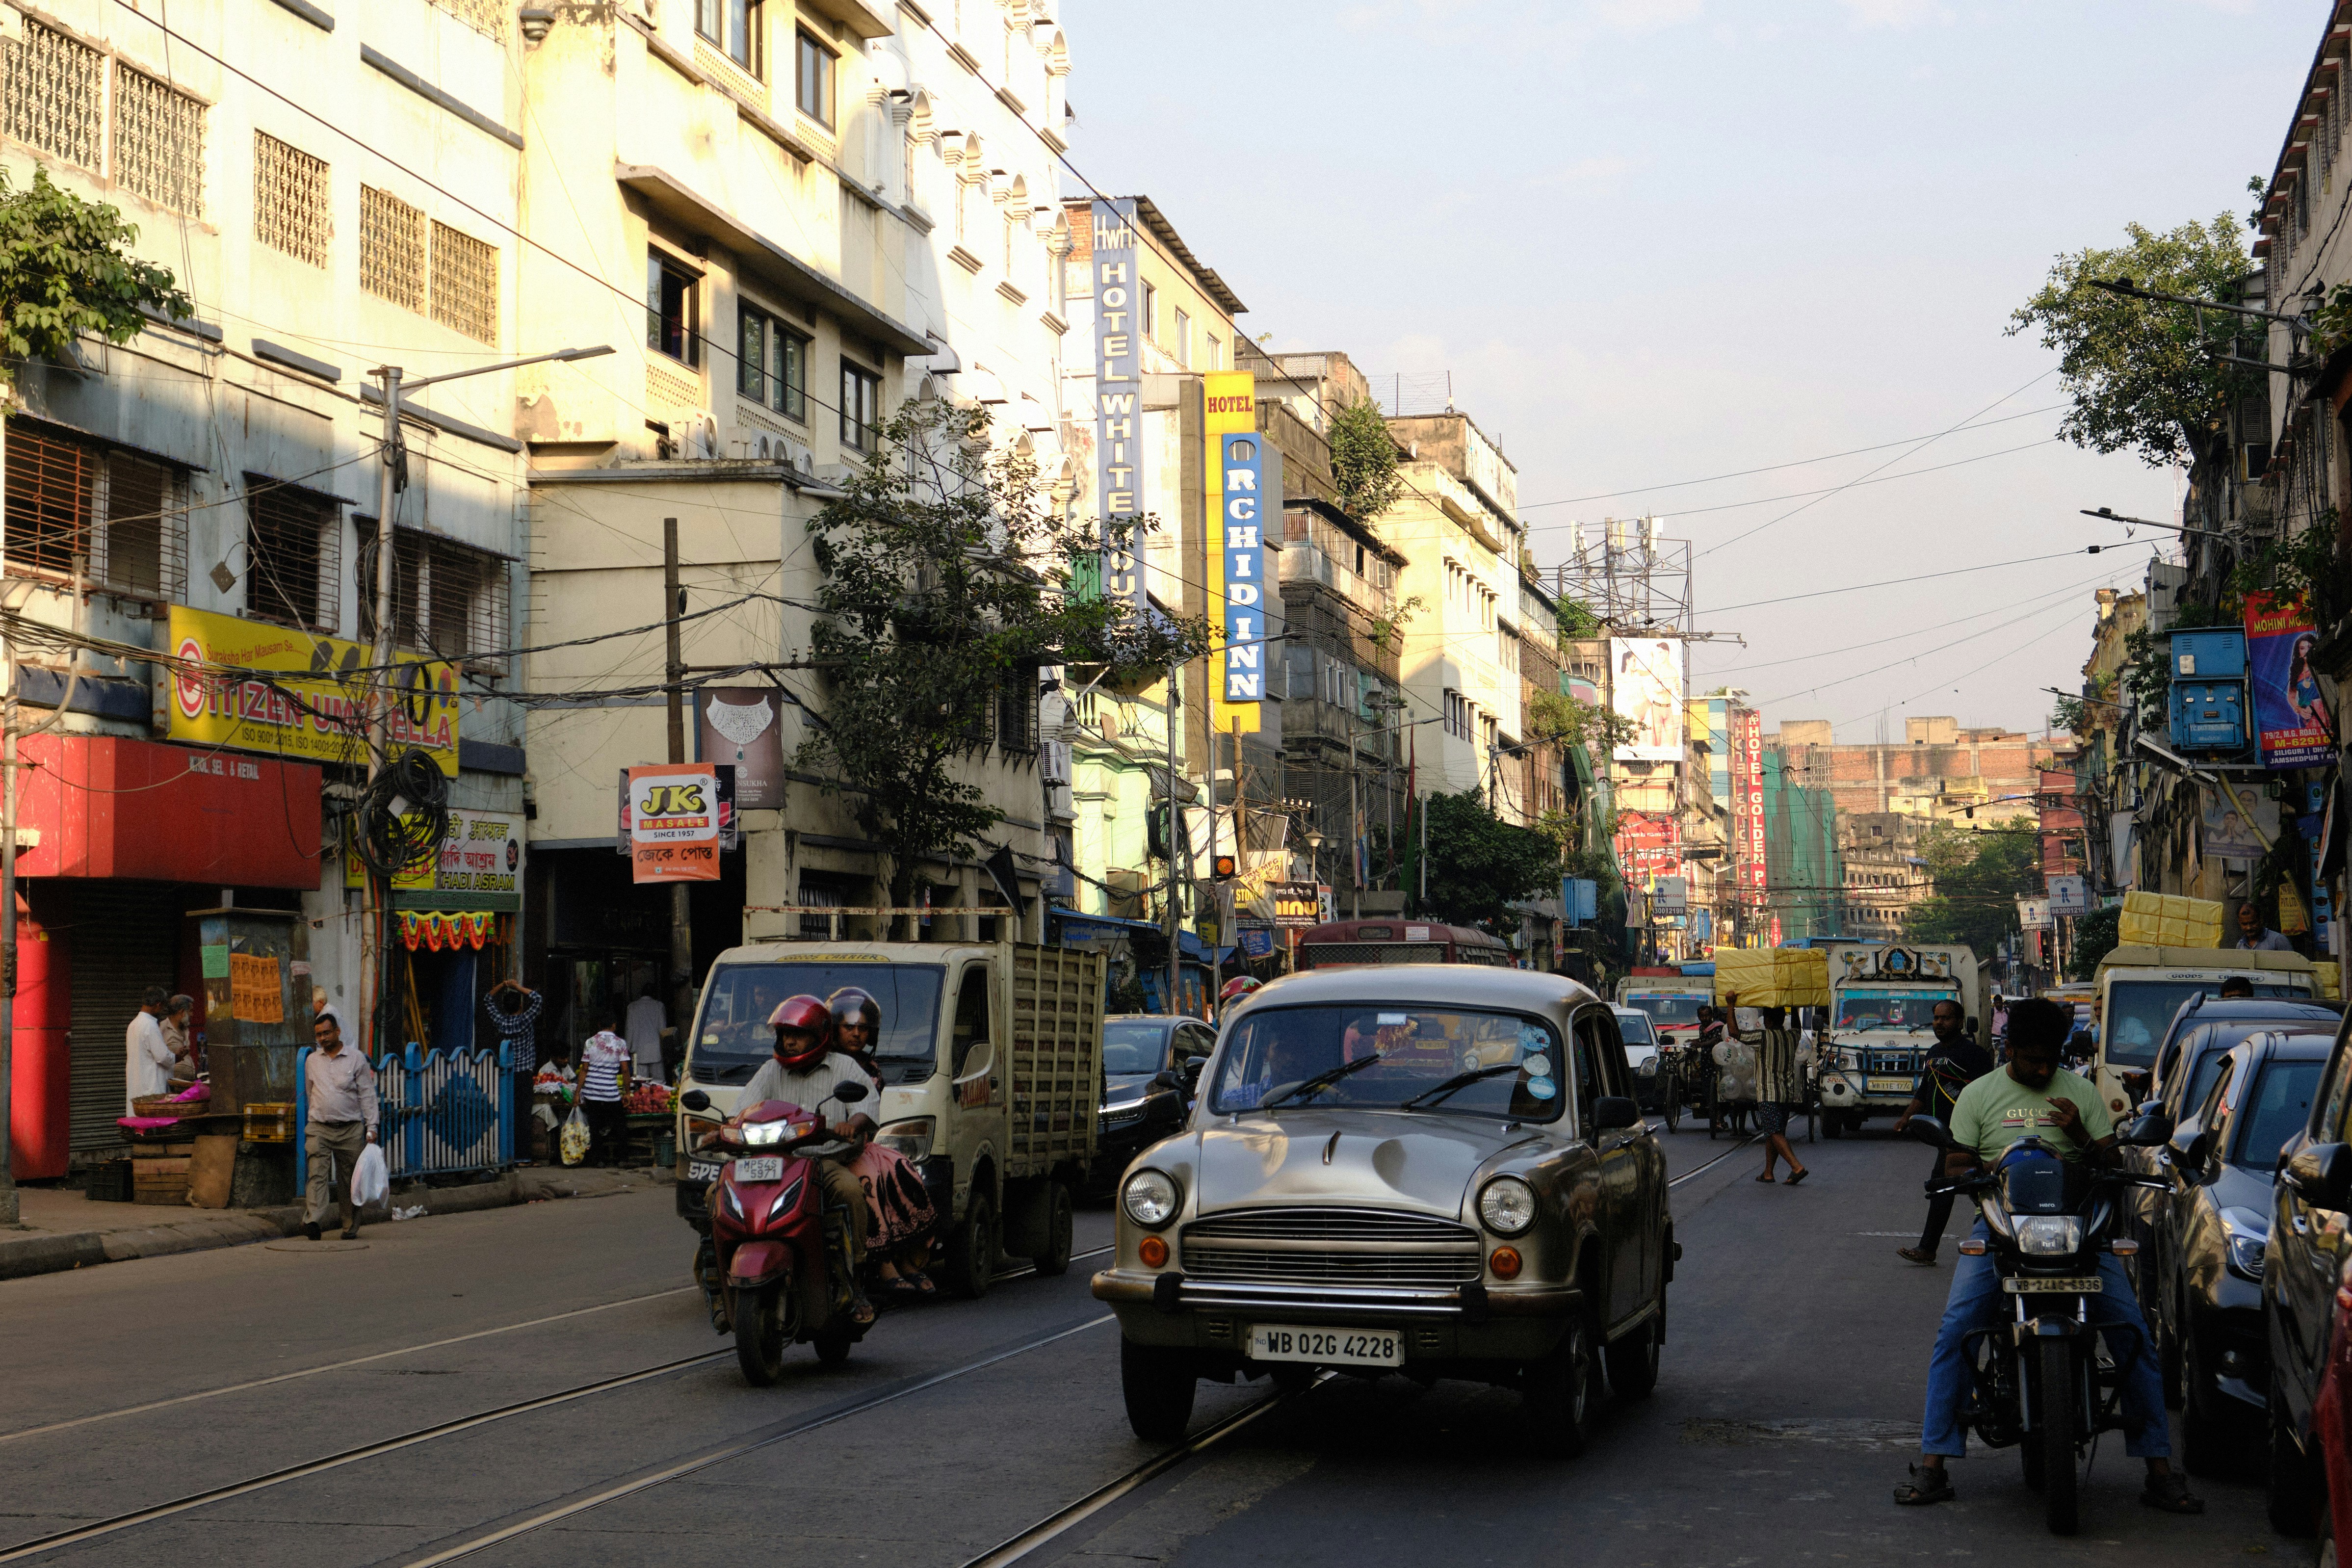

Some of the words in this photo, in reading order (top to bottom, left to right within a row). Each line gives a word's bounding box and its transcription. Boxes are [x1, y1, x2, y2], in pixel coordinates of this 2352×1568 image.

[1101, 262, 1129, 381] HOTEL
[1208, 395, 1253, 413] HOTEL
[1100, 393, 1134, 513] WHITE
[1228, 439, 1258, 605] ORCHID
[2254, 617, 2286, 633] MOHINI
[241, 651, 253, 663] Har
[255, 642, 283, 660] Mausam
[1229, 617, 1259, 697] INN
[241, 727, 255, 741] ISO
[295, 736, 308, 750] ISO
[2265, 731, 2282, 740] 79/2,
[2284, 729, 2298, 738] M.G.
[2299, 727, 2318, 736] ROAD,
[1748, 726, 1761, 786] HOTEL
[2269, 754, 2319, 764] JAMSHEDPUR
[2274, 748, 2305, 757] SILIGURI
[237, 762, 259, 780] RETAIL
[640, 784, 707, 816] JK
[469, 820, 509, 841] आश्रम
[643, 817, 705, 829] MASALE
[1750, 792, 1765, 865] GOLDEN
[637, 847, 674, 862] জেকে
[680, 845, 713, 861] পোস্ত
[442, 871, 471, 889] HADI
[472, 872, 515, 891] ASRAM
[2007, 1108, 2052, 1118] GUCC
[751, 1169, 776, 1178] 5971
[1268, 1332, 1293, 1354] WB
[1299, 1333, 1337, 1356] 02G
[1343, 1335, 1395, 1359] 4228
